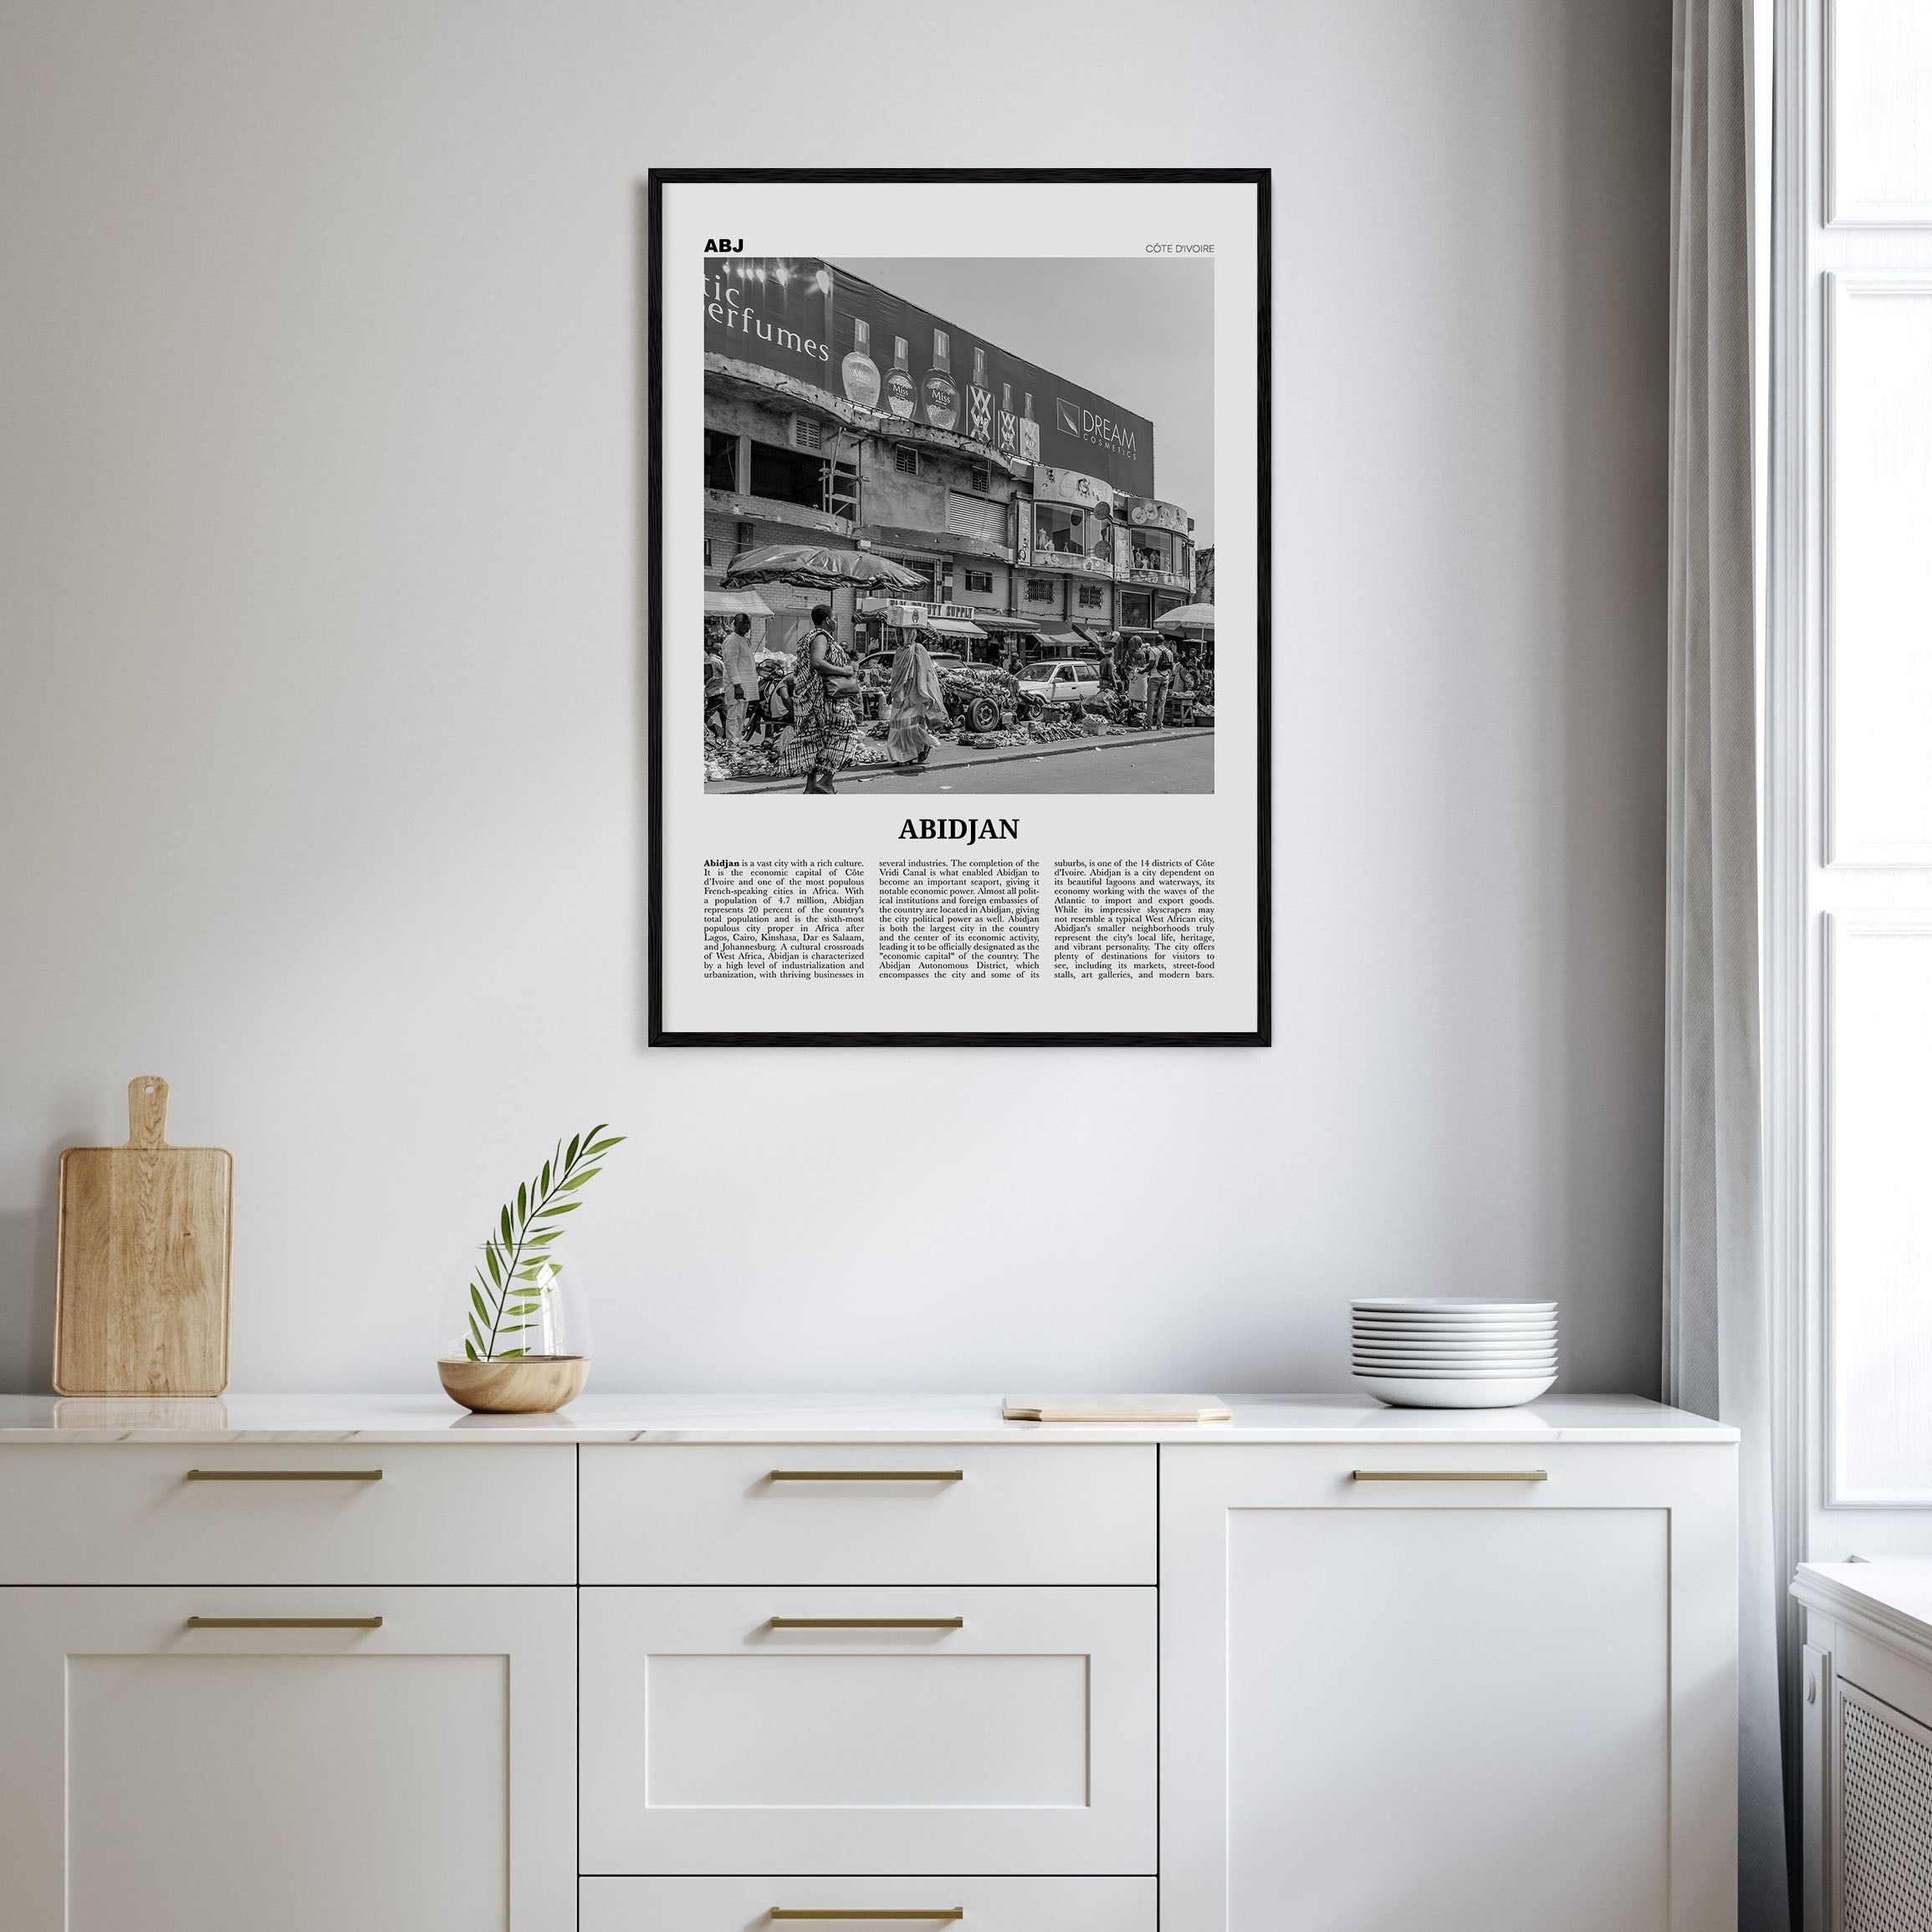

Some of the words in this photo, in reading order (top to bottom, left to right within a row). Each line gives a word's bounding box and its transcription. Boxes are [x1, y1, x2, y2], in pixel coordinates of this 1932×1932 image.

[703, 238, 744, 253] ABJ
[1145, 242, 1173, 253] CÔTE
[1175, 244, 1214, 253] D'IVOIRE
[704, 302, 829, 361] erfumes
[892, 384, 909, 396] Miss
[932, 389, 951, 404] Miss
[1083, 409, 1137, 452] DREAM
[1083, 433, 1137, 461] COSMETICS
[946, 605, 974, 619] SUPPLY
[897, 819, 1020, 846] ABIDJAN
[704, 860, 739, 869] Abidjan
[774, 861, 789, 869] city
[969, 860, 1013, 869] completion
[1054, 860, 1086, 868] suburbs,
[795, 869, 821, 878] capital
[997, 869, 1027, 878] Abidjan
[1090, 869, 1121, 878] Abidjan
[1142, 870, 1157, 878] city
[1160, 869, 1201, 878] dependent
[829, 878, 864, 887] populous
[928, 879, 966, 887] important
[971, 879, 1002, 887] seaport,
[1006, 879, 1030, 887] giving
[1107, 878, 1136, 887] lagoons
[1159, 879, 1201, 887] waterways,
[704, 887, 768, 897] French-speaking
[1019, 887, 1039, 897] polit-
[1093, 887, 1124, 897] working
[715, 897, 757, 906] population
[797, 897, 826, 905] million,
[833, 897, 864, 906] Abidjan
[959, 897, 986, 906] foreign
[1106, 897, 1132, 906] import
[1158, 897, 1183, 906] export
[1189, 897, 1214, 906] goods.
[704, 907, 744, 915] represents
[764, 907, 792, 915] percent
[893, 907, 923, 915] country
[980, 906, 1014, 915] Abidjan,
[1015, 907, 1040, 915] giving
[1101, 907, 1140, 915] impressive
[1147, 906, 1191, 915] skyscrapers
[727, 915, 769, 924] population
[895, 916, 909, 924] city
[912, 915, 943, 924] political
[1008, 915, 1039, 924] Abidjan
